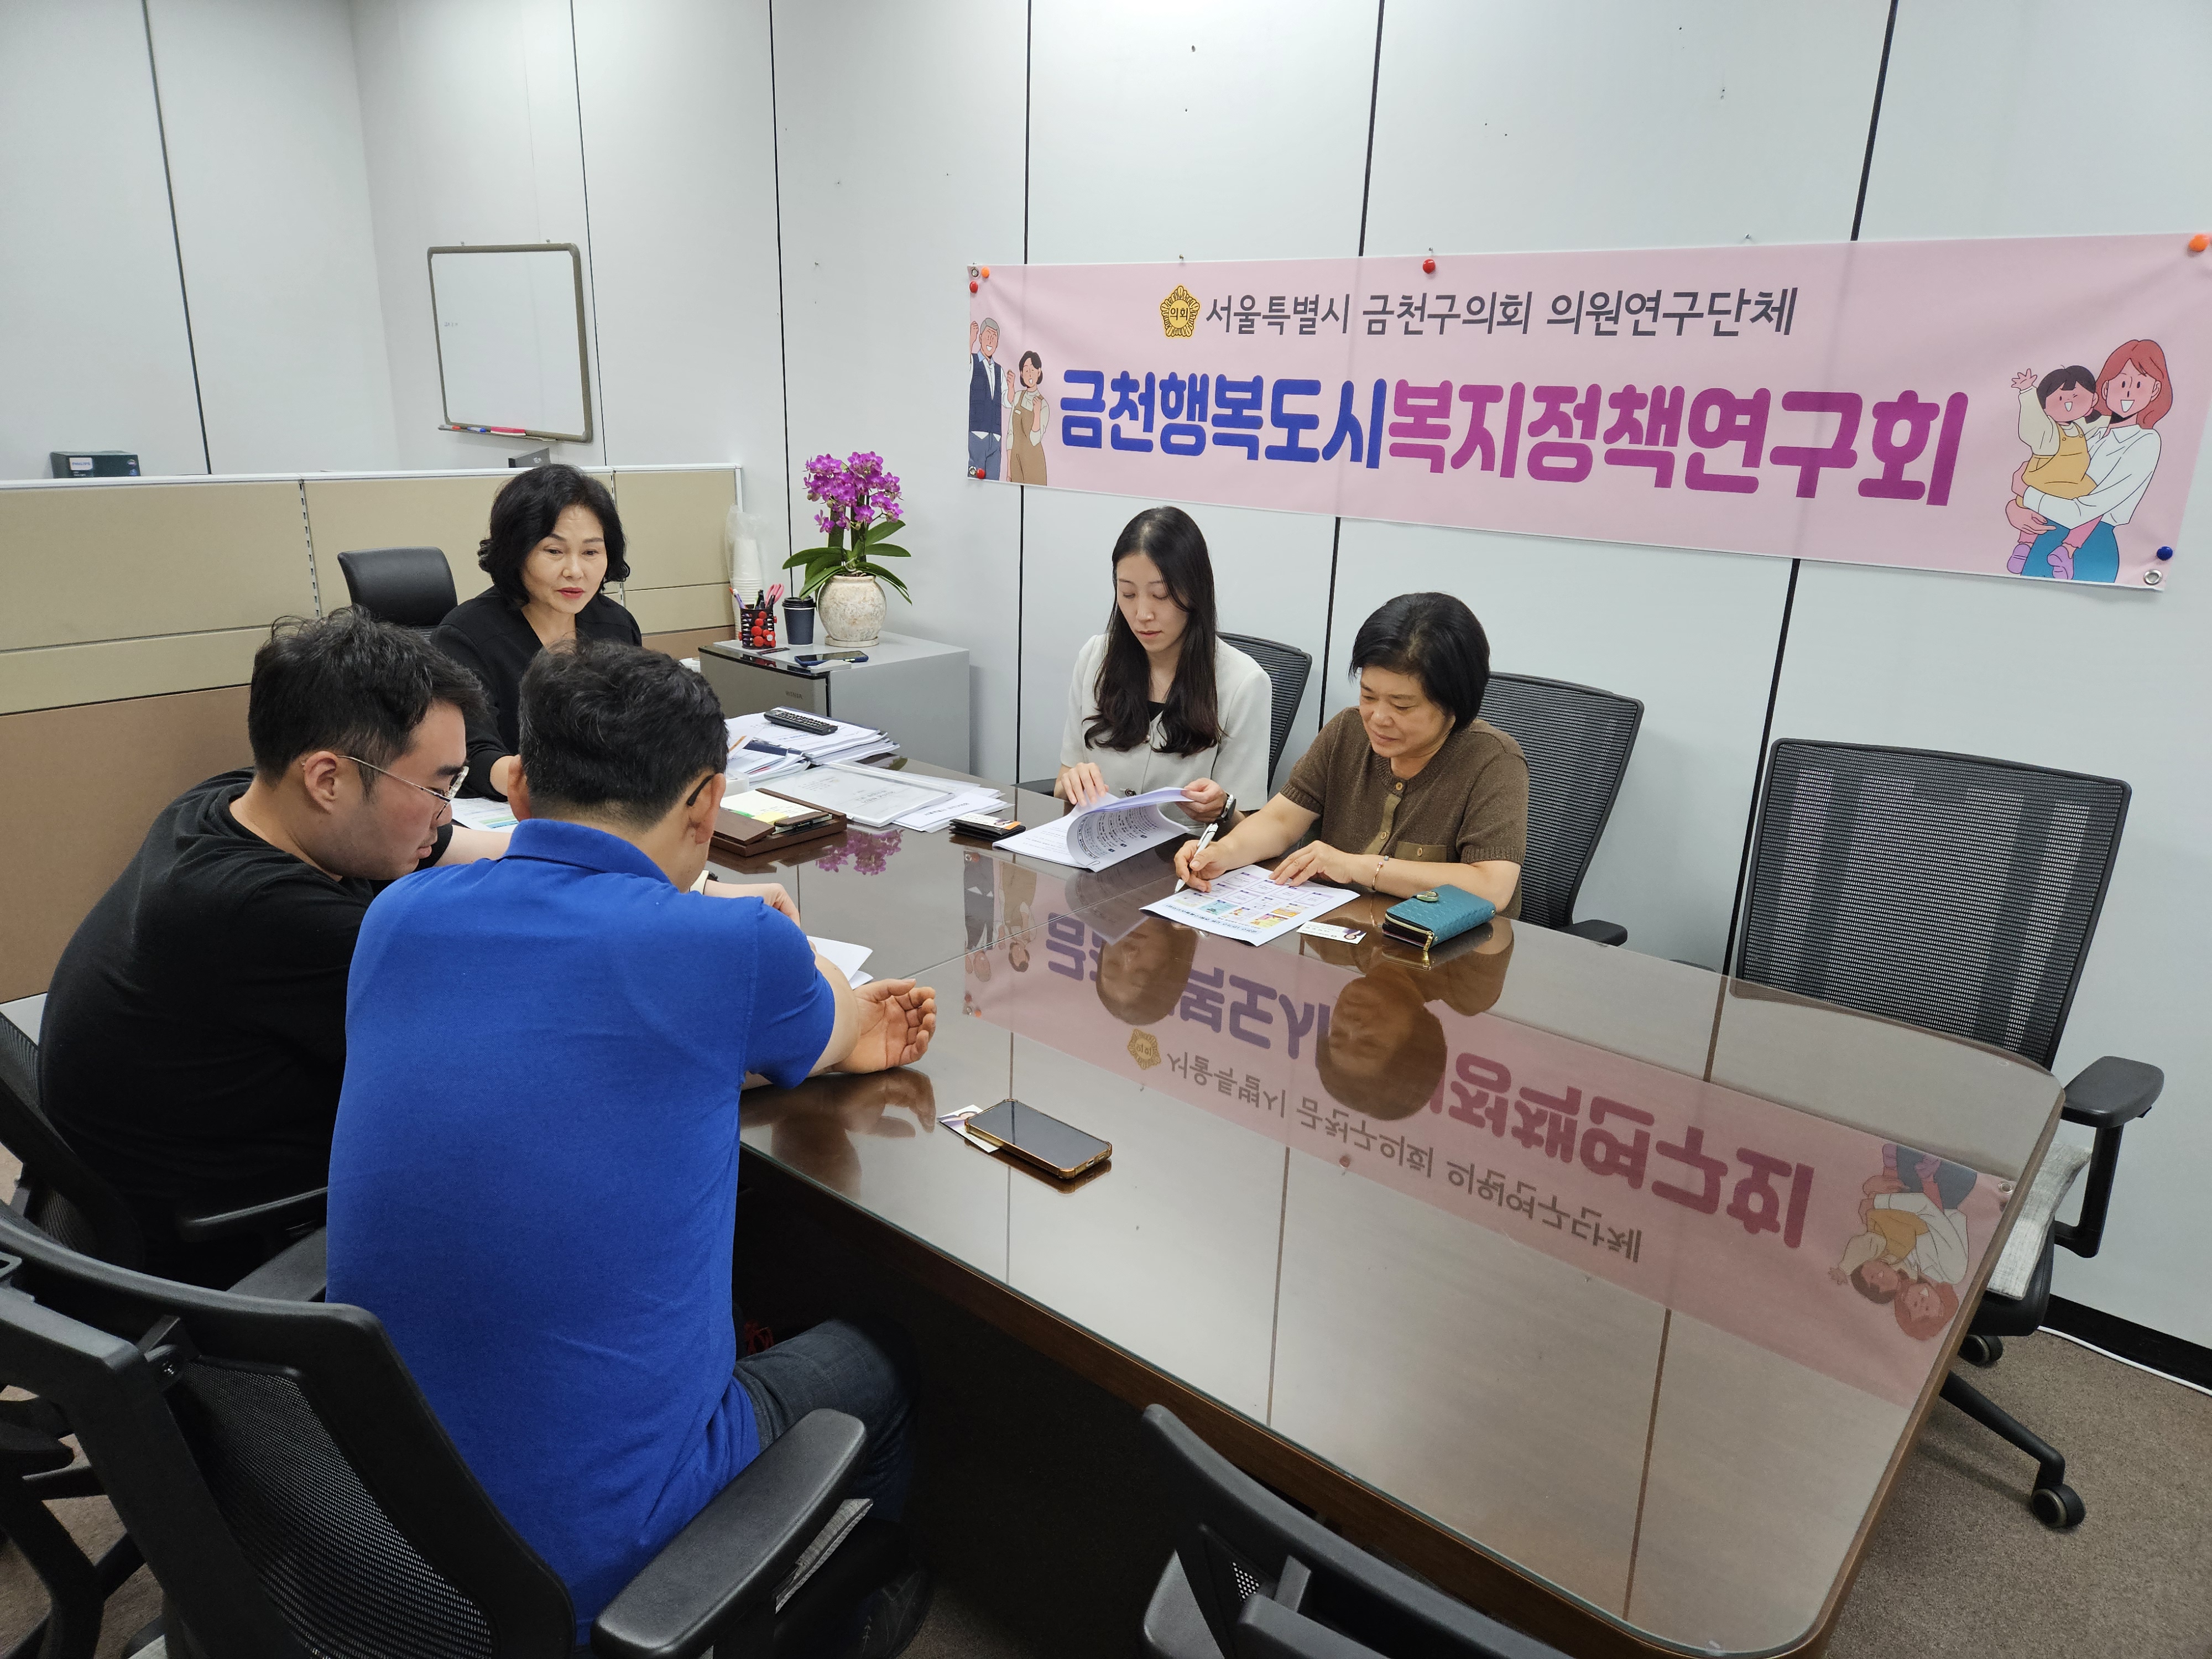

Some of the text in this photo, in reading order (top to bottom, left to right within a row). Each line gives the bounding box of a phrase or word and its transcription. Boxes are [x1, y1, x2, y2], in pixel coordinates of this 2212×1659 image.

[1170, 307, 1188, 321] 의회
[1206, 287, 1798, 337] 서울특별시 금천구의회 의원연구단체
